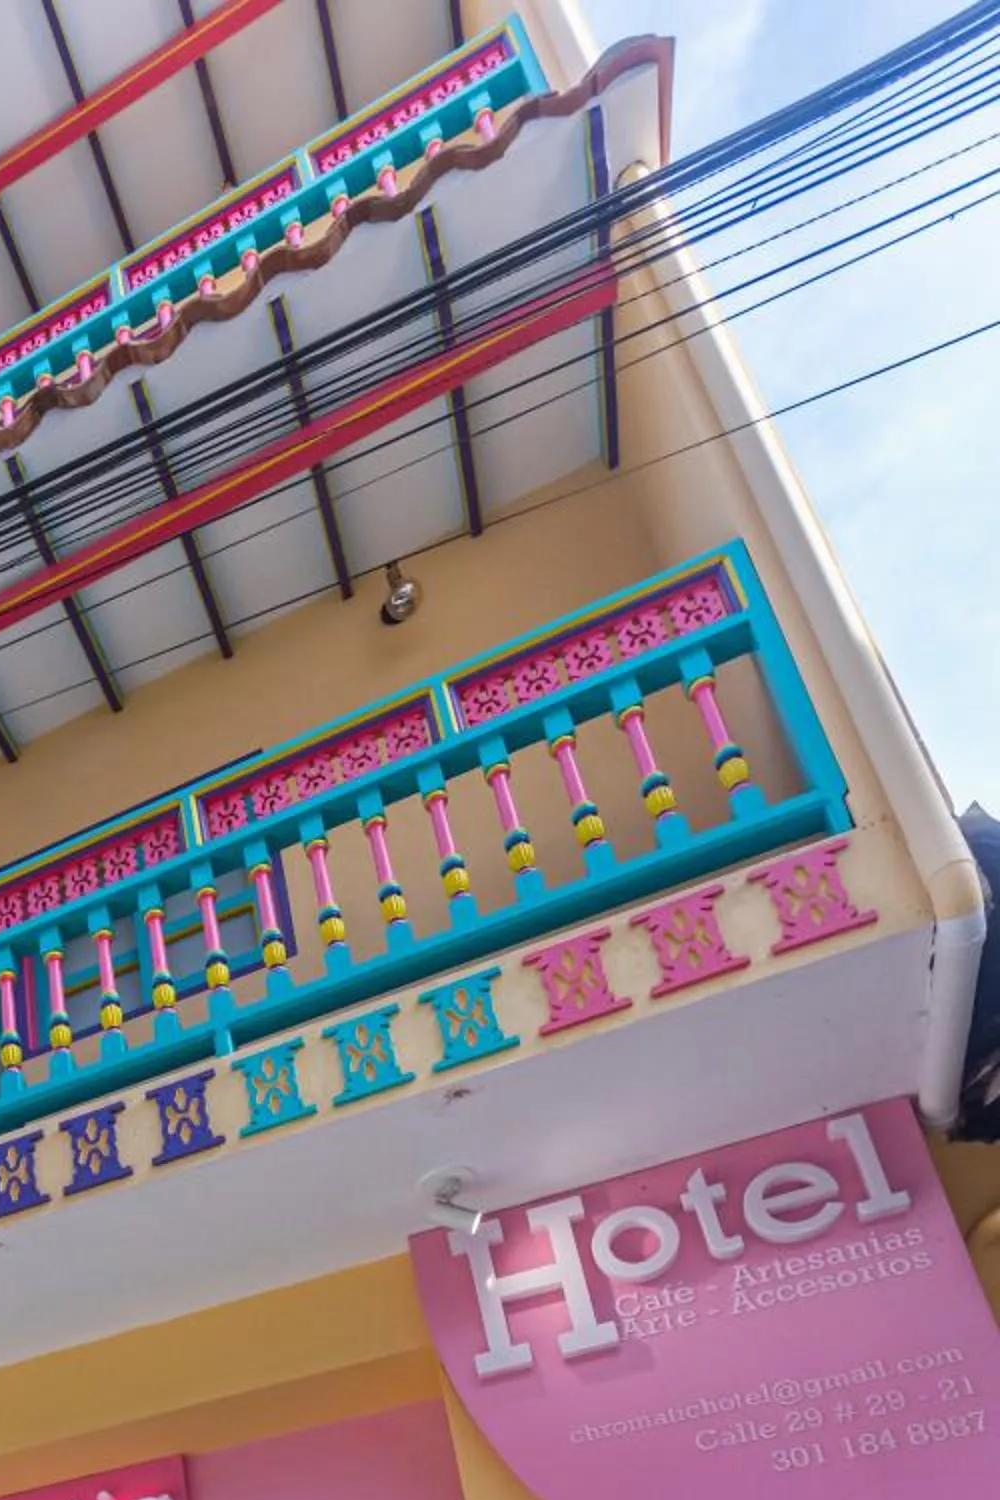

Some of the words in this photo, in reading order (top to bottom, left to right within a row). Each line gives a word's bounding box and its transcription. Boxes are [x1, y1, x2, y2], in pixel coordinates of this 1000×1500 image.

[448, 1113, 912, 1377] Hotel
[614, 1279, 696, 1319] Café
[619, 1309, 698, 1341] Arte
[729, 1250, 935, 1316] Accesorios
[694, 1421, 778, 1453] Calle
[785, 1406, 825, 1433] 29
[936, 1374, 977, 1403] 21
[770, 1442, 825, 1473] 301
[840, 1427, 898, 1461] 184
